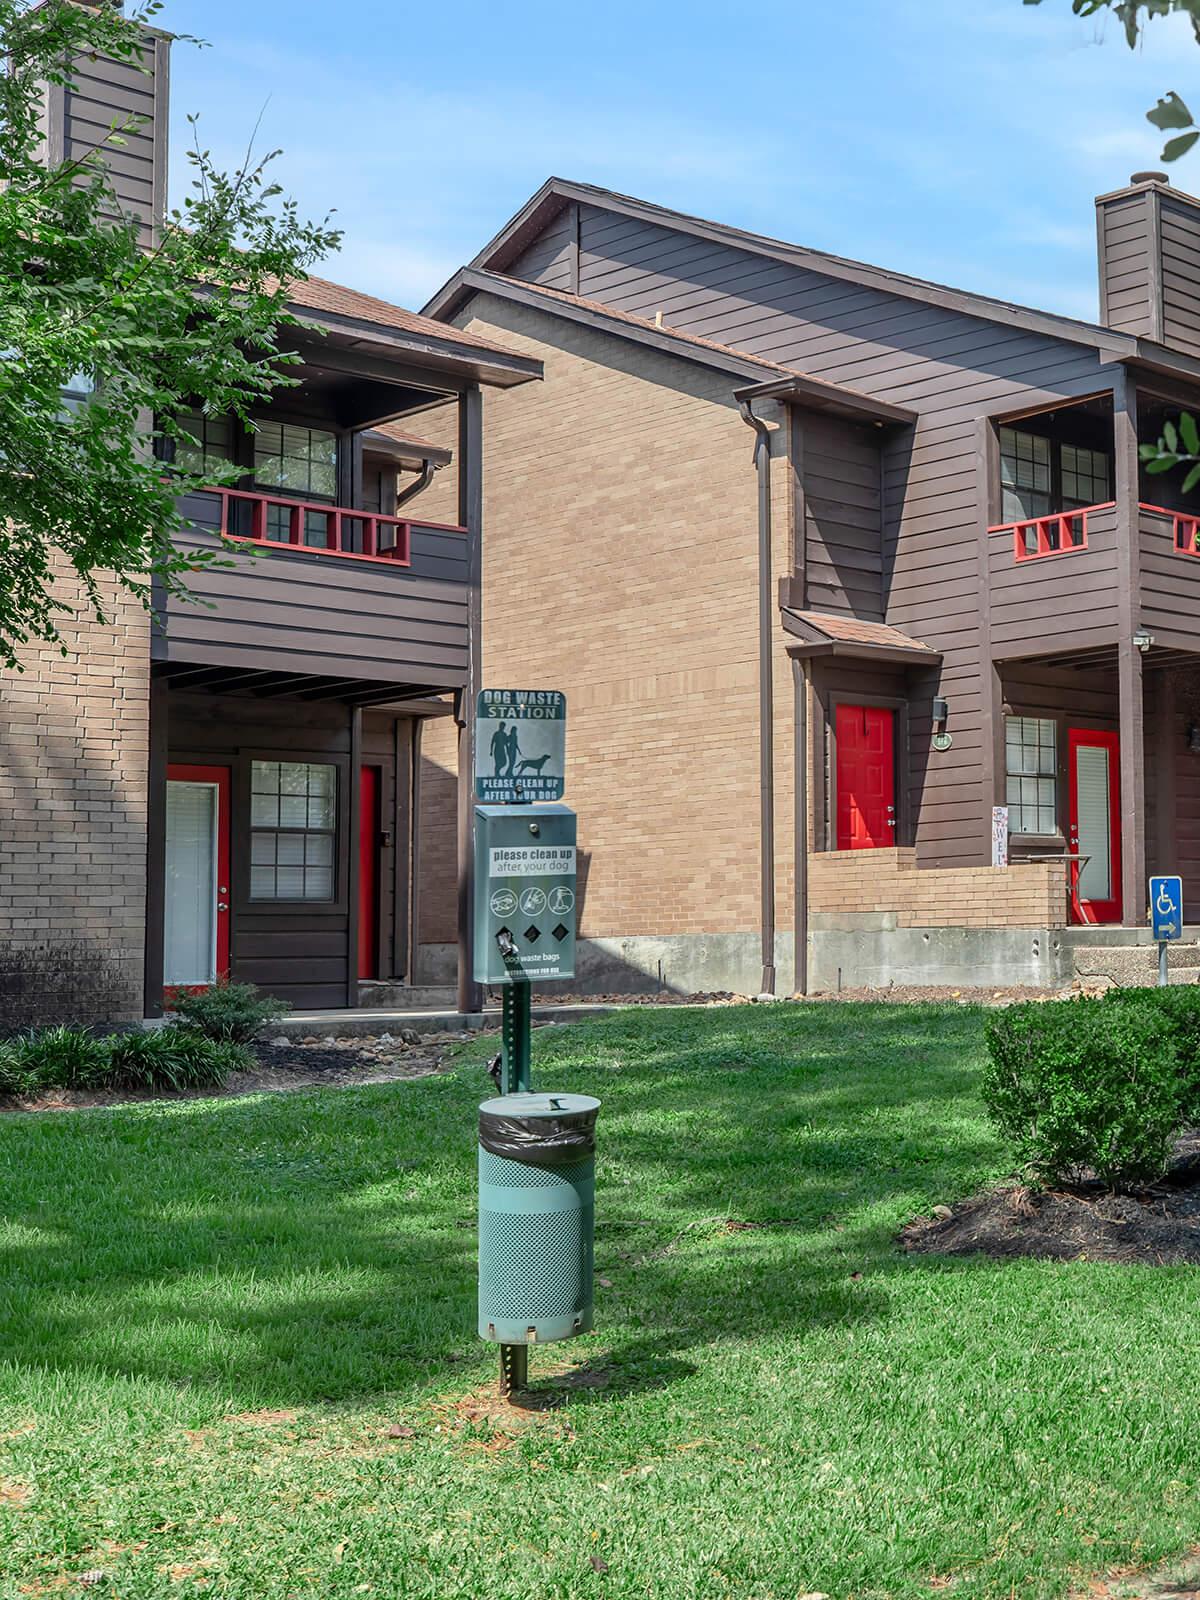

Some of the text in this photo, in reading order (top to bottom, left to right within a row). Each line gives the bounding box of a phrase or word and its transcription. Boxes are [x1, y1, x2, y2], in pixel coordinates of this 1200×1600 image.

[484, 690, 561, 705] DOG WASTE
[488, 706, 556, 719] STATION
[482, 778, 559, 788] PLEASE CLEAN UP
[484, 790, 511, 800] AFTER
[539, 790, 557, 800] DOG
[493, 849, 572, 862] please clean up
[497, 860, 569, 873] after your dog
[520, 954, 542, 962] waste
[542, 952, 560, 962] bags
